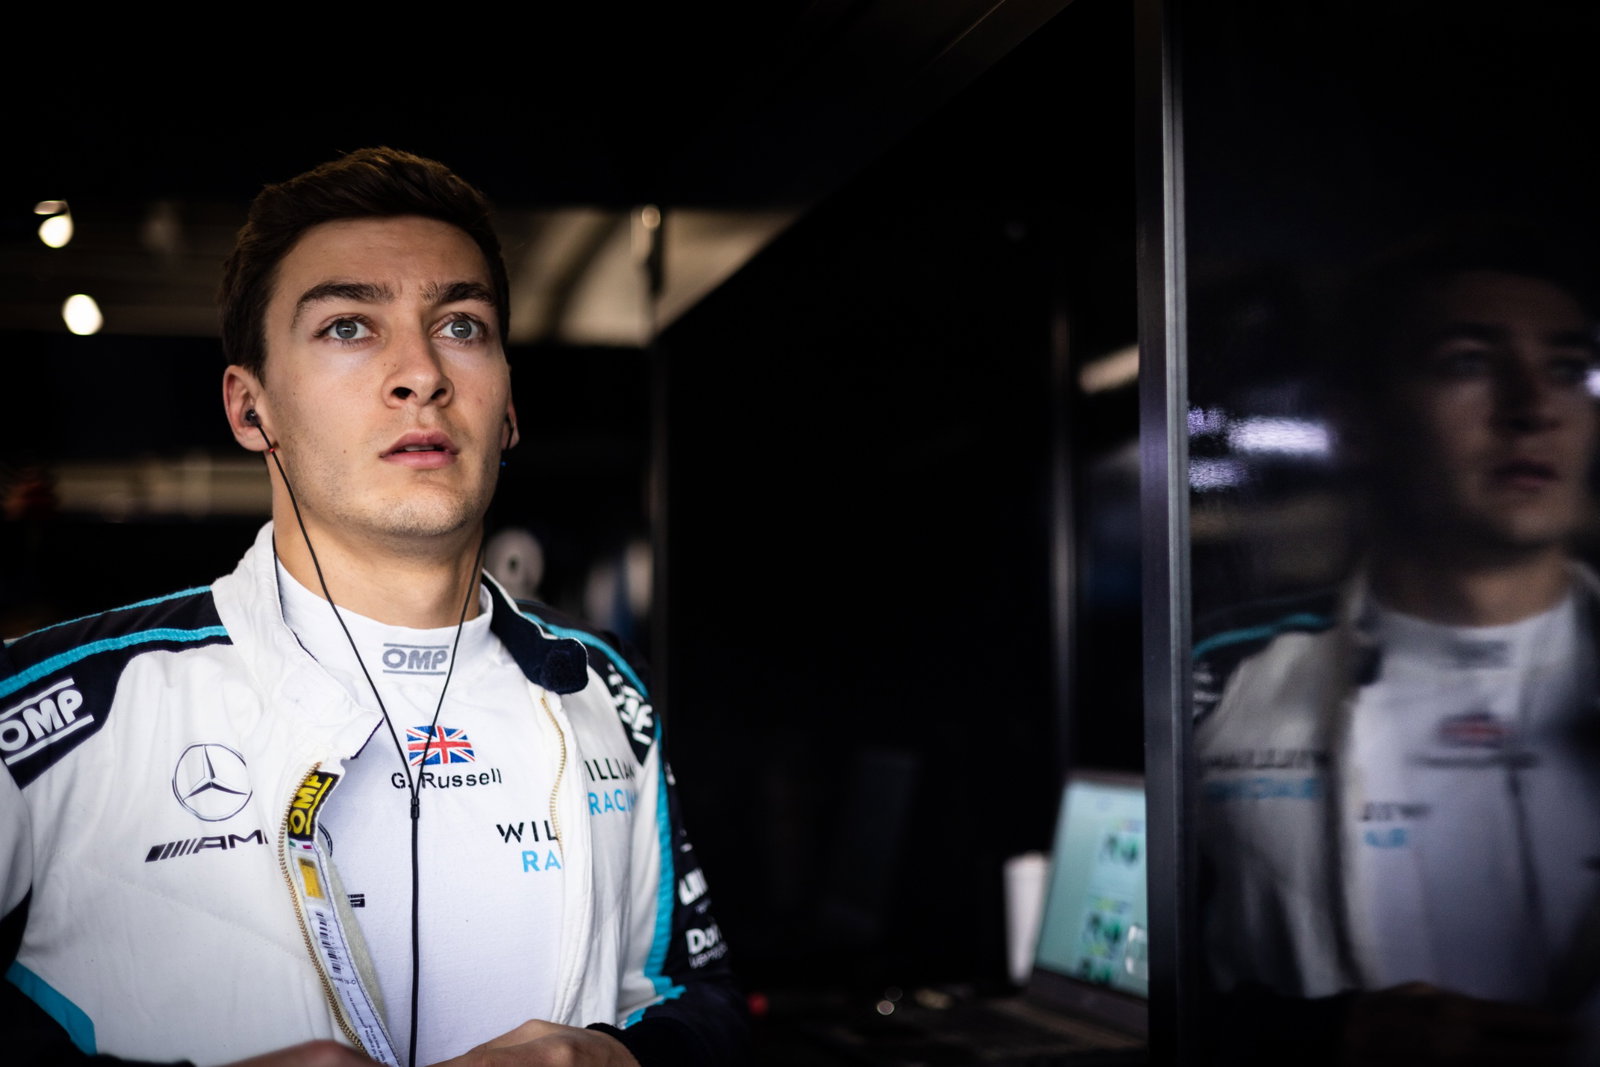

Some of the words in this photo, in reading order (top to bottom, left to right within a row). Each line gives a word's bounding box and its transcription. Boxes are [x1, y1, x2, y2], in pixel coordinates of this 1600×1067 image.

[382, 648, 448, 670] OMP
[0, 689, 83, 752] OMP
[420, 768, 502, 789] Russell
[290, 775, 322, 834] OMP
[193, 829, 269, 854] AM
[496, 820, 559, 843] WIL
[522, 850, 561, 873] RA
